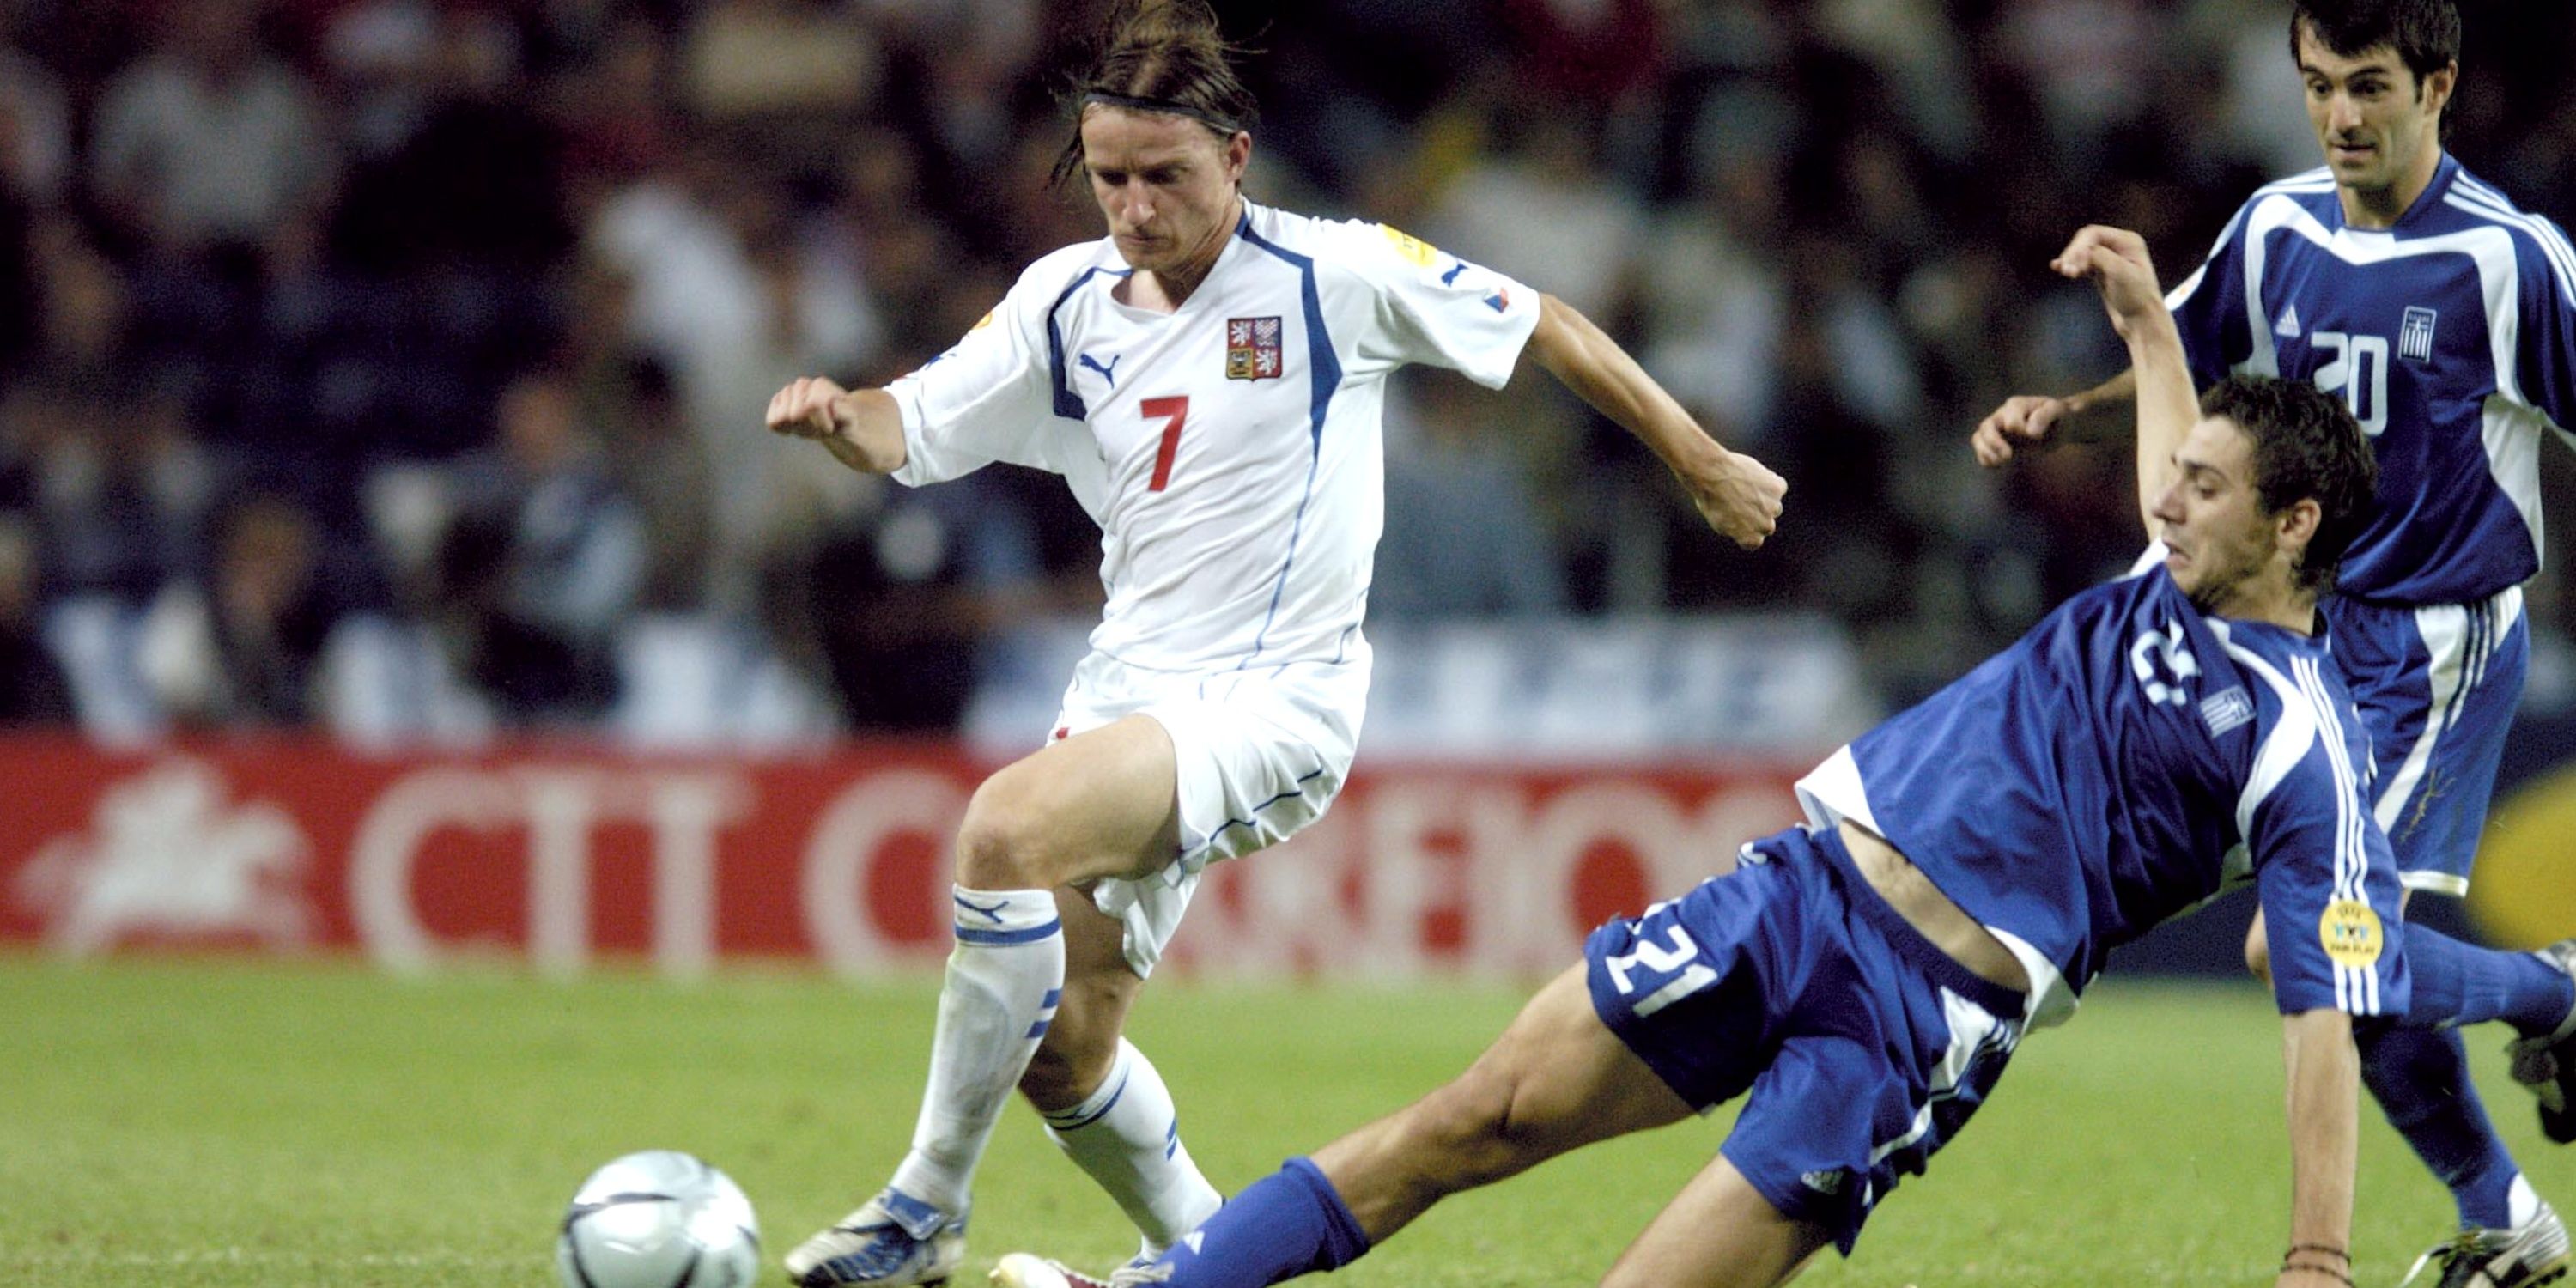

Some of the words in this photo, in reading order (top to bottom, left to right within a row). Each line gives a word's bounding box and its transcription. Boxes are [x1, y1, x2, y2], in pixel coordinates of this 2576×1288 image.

[2311, 331, 2389, 436] 20
[1139, 395, 1189, 492] 7
[349, 767, 759, 981] CTT
[1605, 924, 1718, 1018] 21
